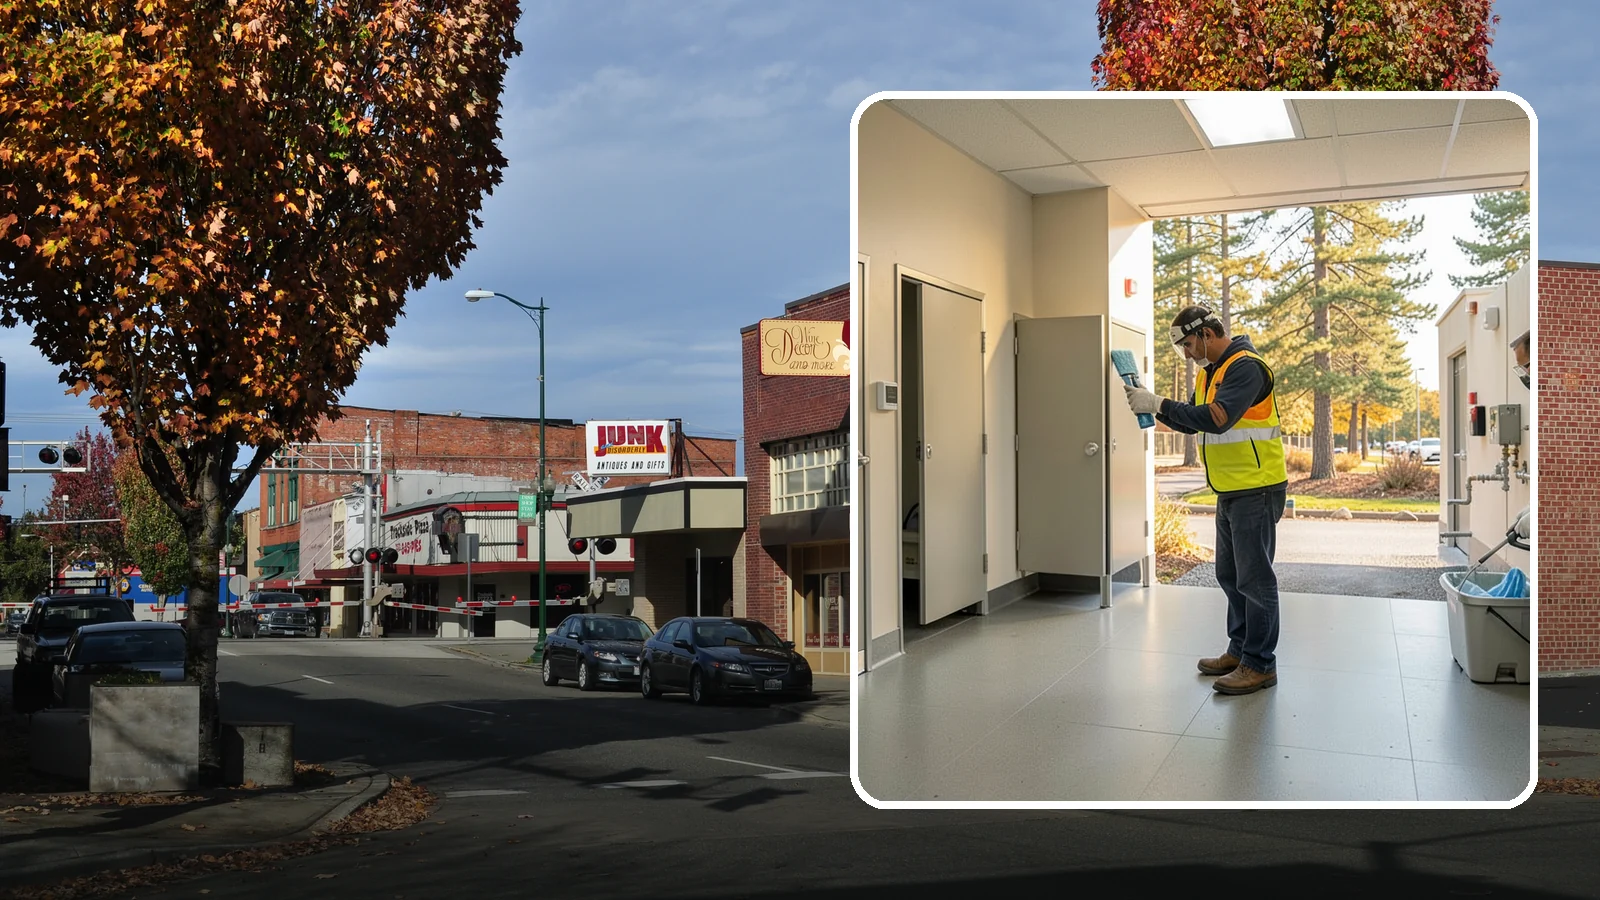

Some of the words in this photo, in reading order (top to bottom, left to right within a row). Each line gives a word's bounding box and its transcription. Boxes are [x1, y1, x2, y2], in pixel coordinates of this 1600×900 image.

[595, 425, 665, 457] JUNK
[607, 446, 646, 454] DISORDERLY
[597, 461, 628, 470] ANTIQUES
[631, 461, 644, 469] AND
[647, 460, 665, 469] GIFTS
[415, 520, 429, 534] Pizza
